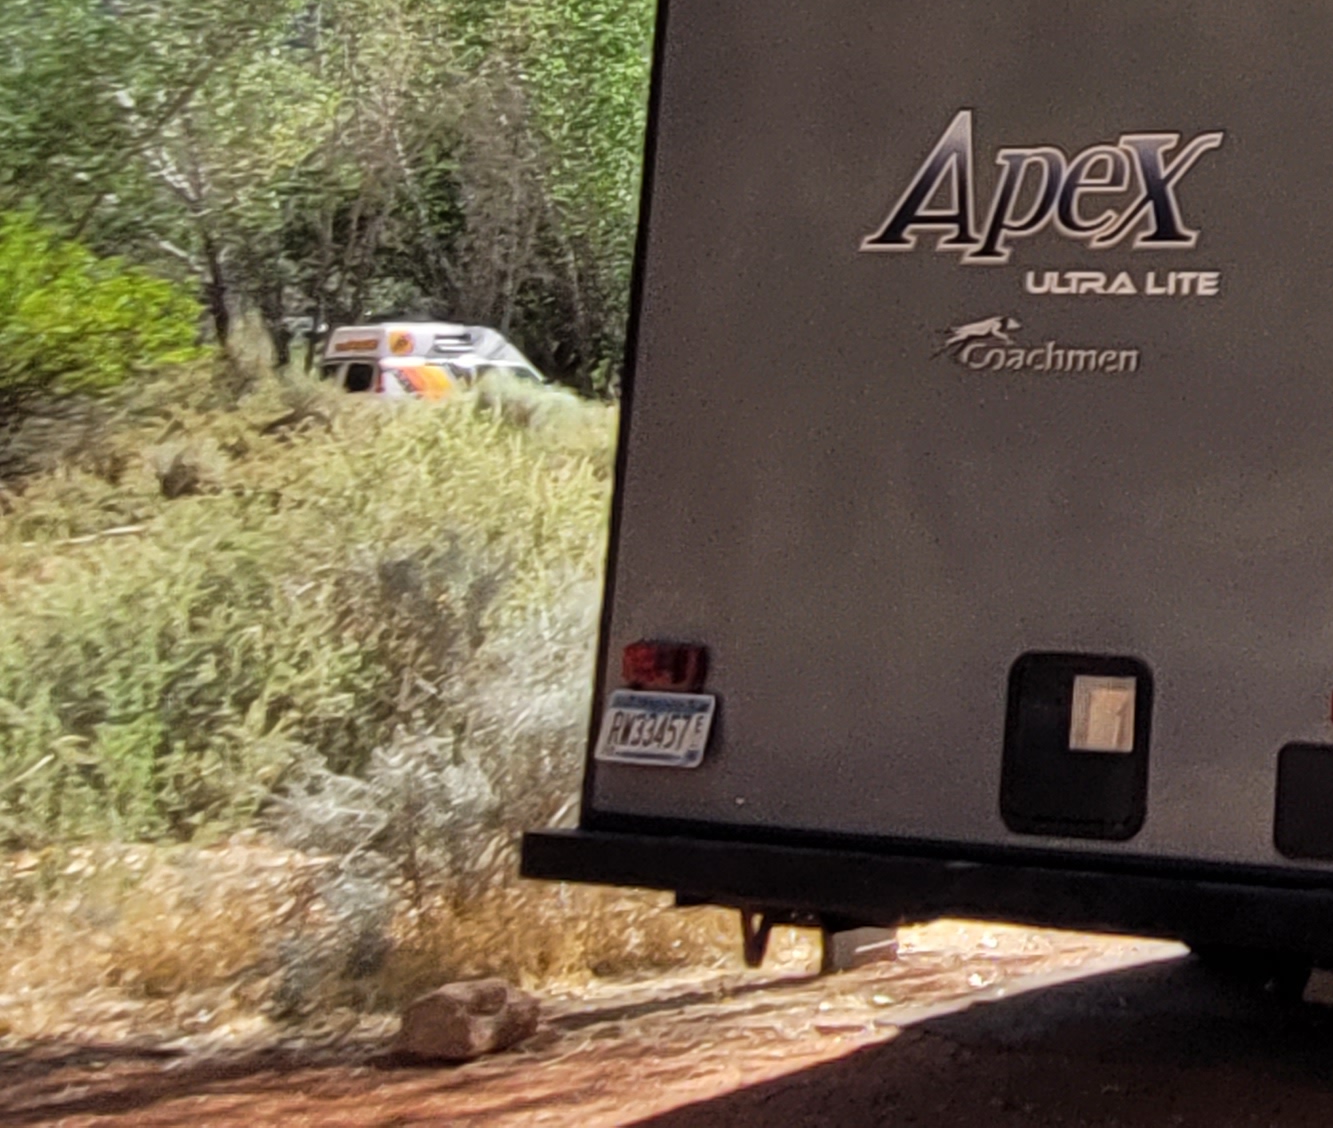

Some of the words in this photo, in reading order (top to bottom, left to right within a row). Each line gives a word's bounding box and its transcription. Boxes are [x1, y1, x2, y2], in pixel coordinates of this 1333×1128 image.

[1025, 271, 1137, 295] ULTRA
[1144, 271, 1221, 296] LITE
[960, 341, 1140, 372] Coachmen
